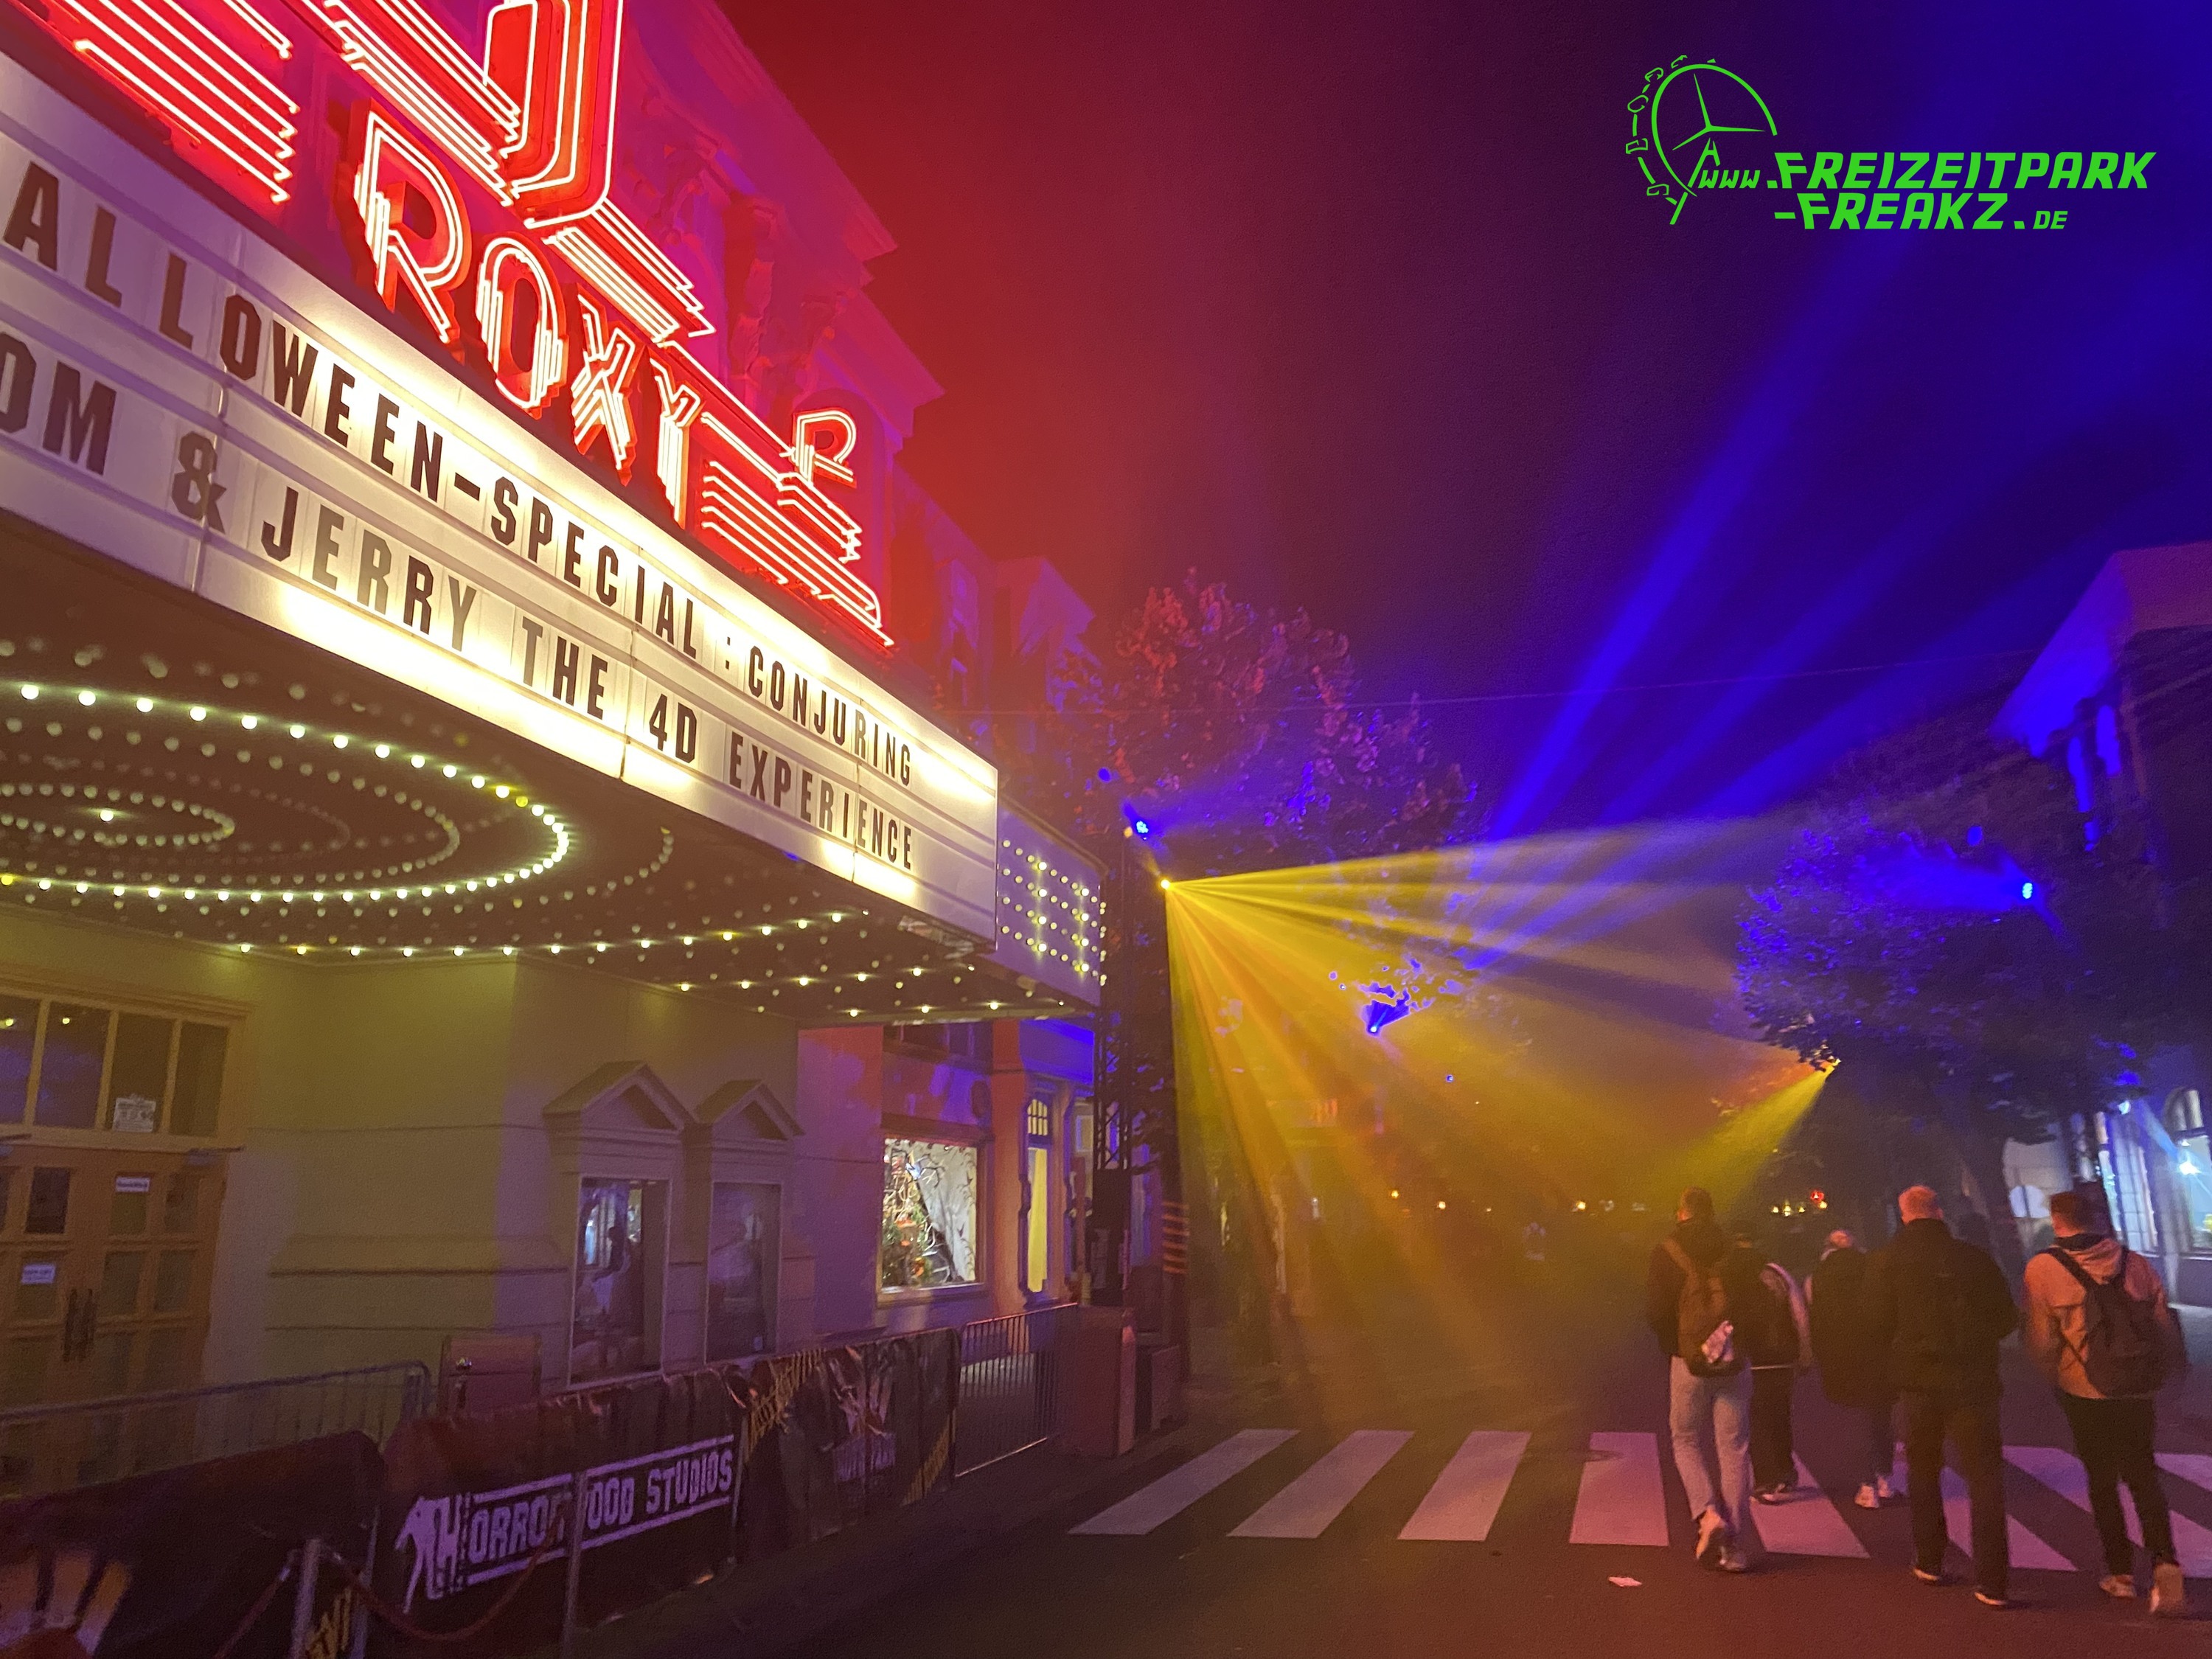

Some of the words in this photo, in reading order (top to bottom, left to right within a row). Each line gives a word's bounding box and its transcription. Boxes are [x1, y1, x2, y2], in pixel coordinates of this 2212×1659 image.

[354, 103, 702, 528] ROXY
[172, 431, 227, 534] &
[261, 486, 477, 652] JERRY
[521, 616, 608, 720] THE
[649, 694, 698, 764] 4D
[729, 731, 911, 870] EXPERIENCE
[748, 645, 911, 787] CONJURING
[646, 1450, 733, 1514] STUDIOS
